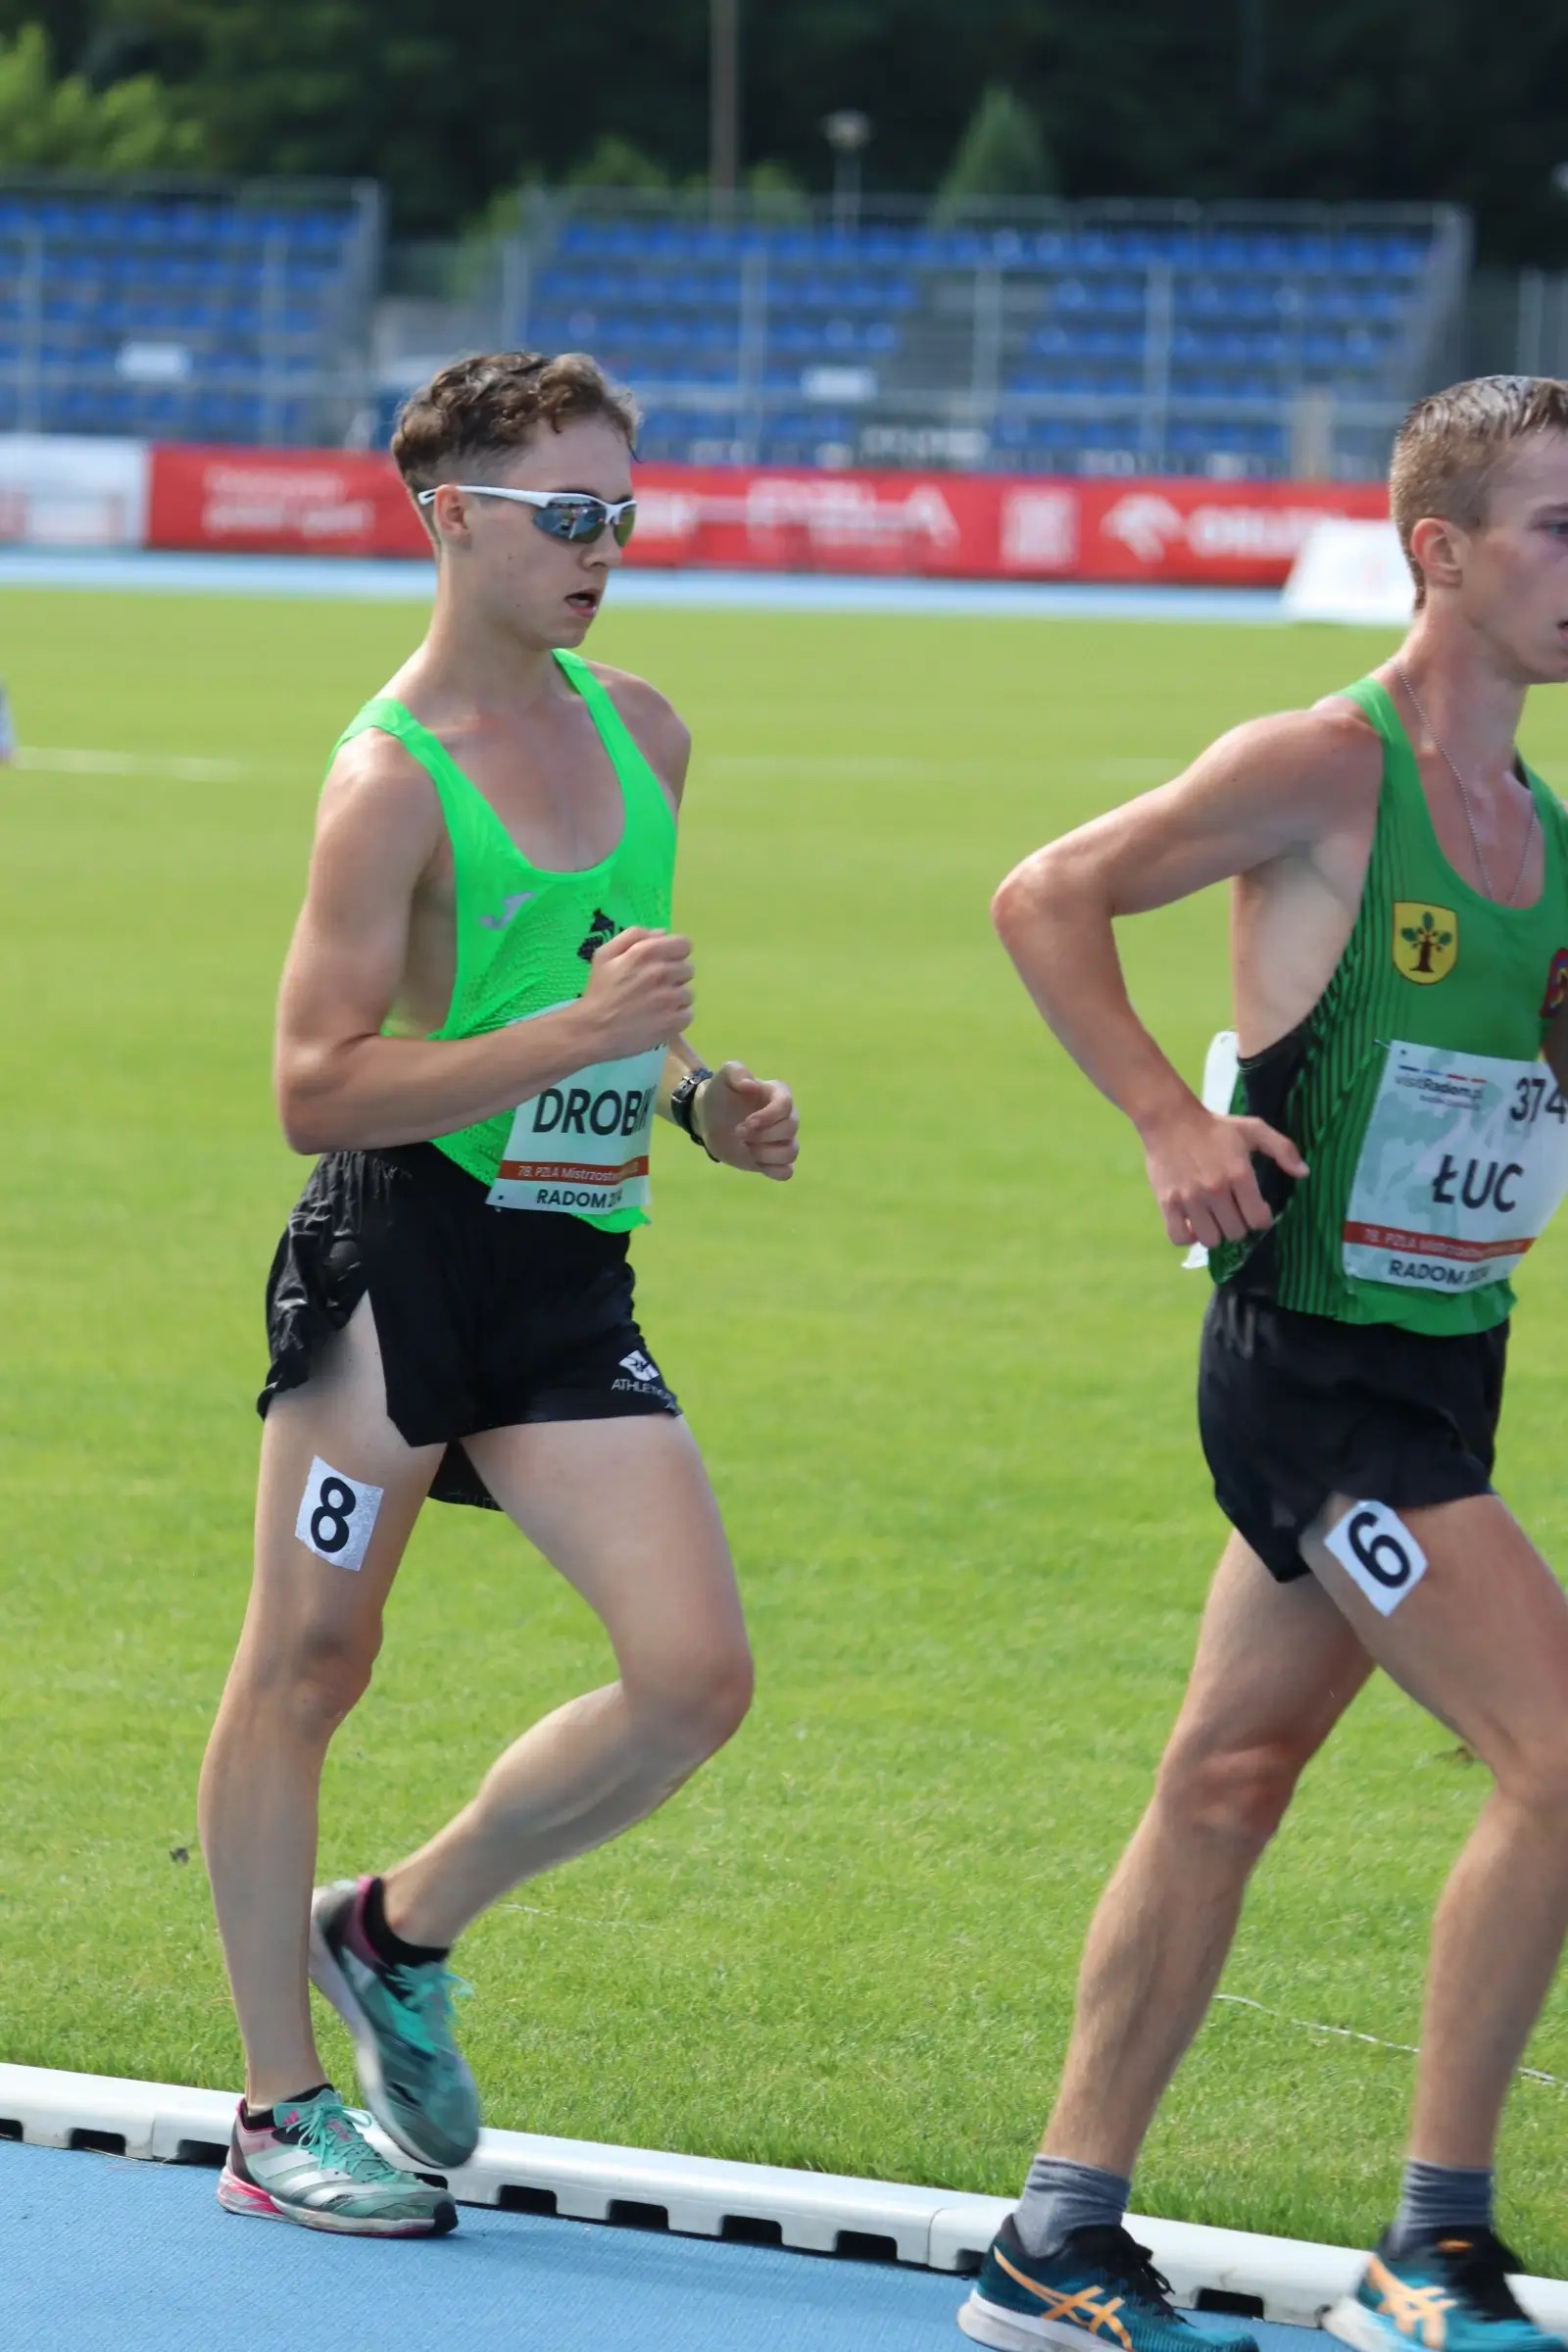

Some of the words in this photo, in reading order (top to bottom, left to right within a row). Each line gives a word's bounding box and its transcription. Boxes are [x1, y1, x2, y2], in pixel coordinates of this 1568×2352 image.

[532, 1085, 657, 1137] DROB
[536, 1188, 607, 1208] RADOM
[1432, 1153, 1524, 1213] ŁUC
[1388, 1258, 1466, 1286] RADOM
[310, 1476, 357, 1553] 8
[1348, 1511, 1411, 1590] 6
